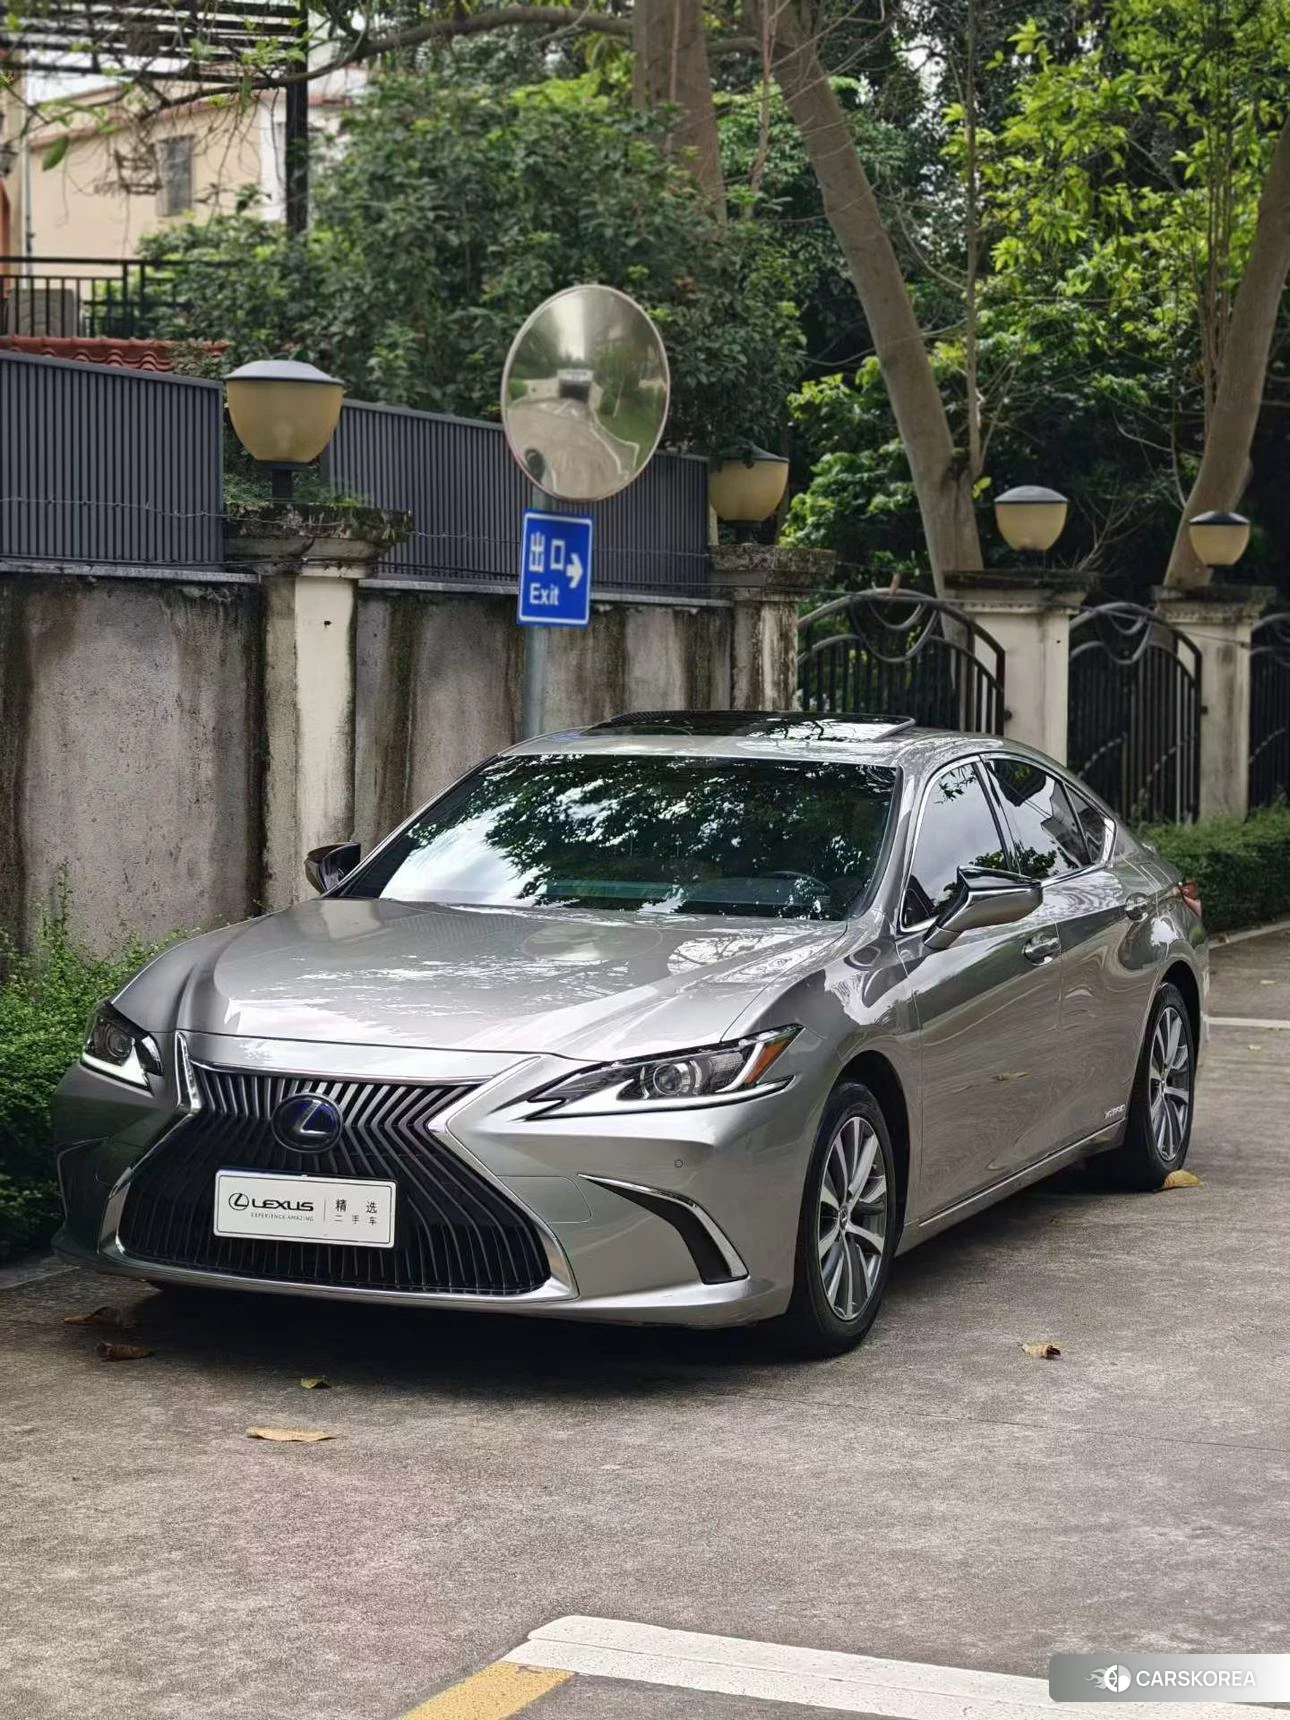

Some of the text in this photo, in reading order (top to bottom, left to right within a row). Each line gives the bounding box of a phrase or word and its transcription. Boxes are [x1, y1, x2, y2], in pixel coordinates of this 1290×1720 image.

[529, 531, 565, 573] 出口
[529, 582, 559, 606] Exit
[251, 1198, 314, 1212] LEXUS
[334, 1214, 377, 1226] 二手车
